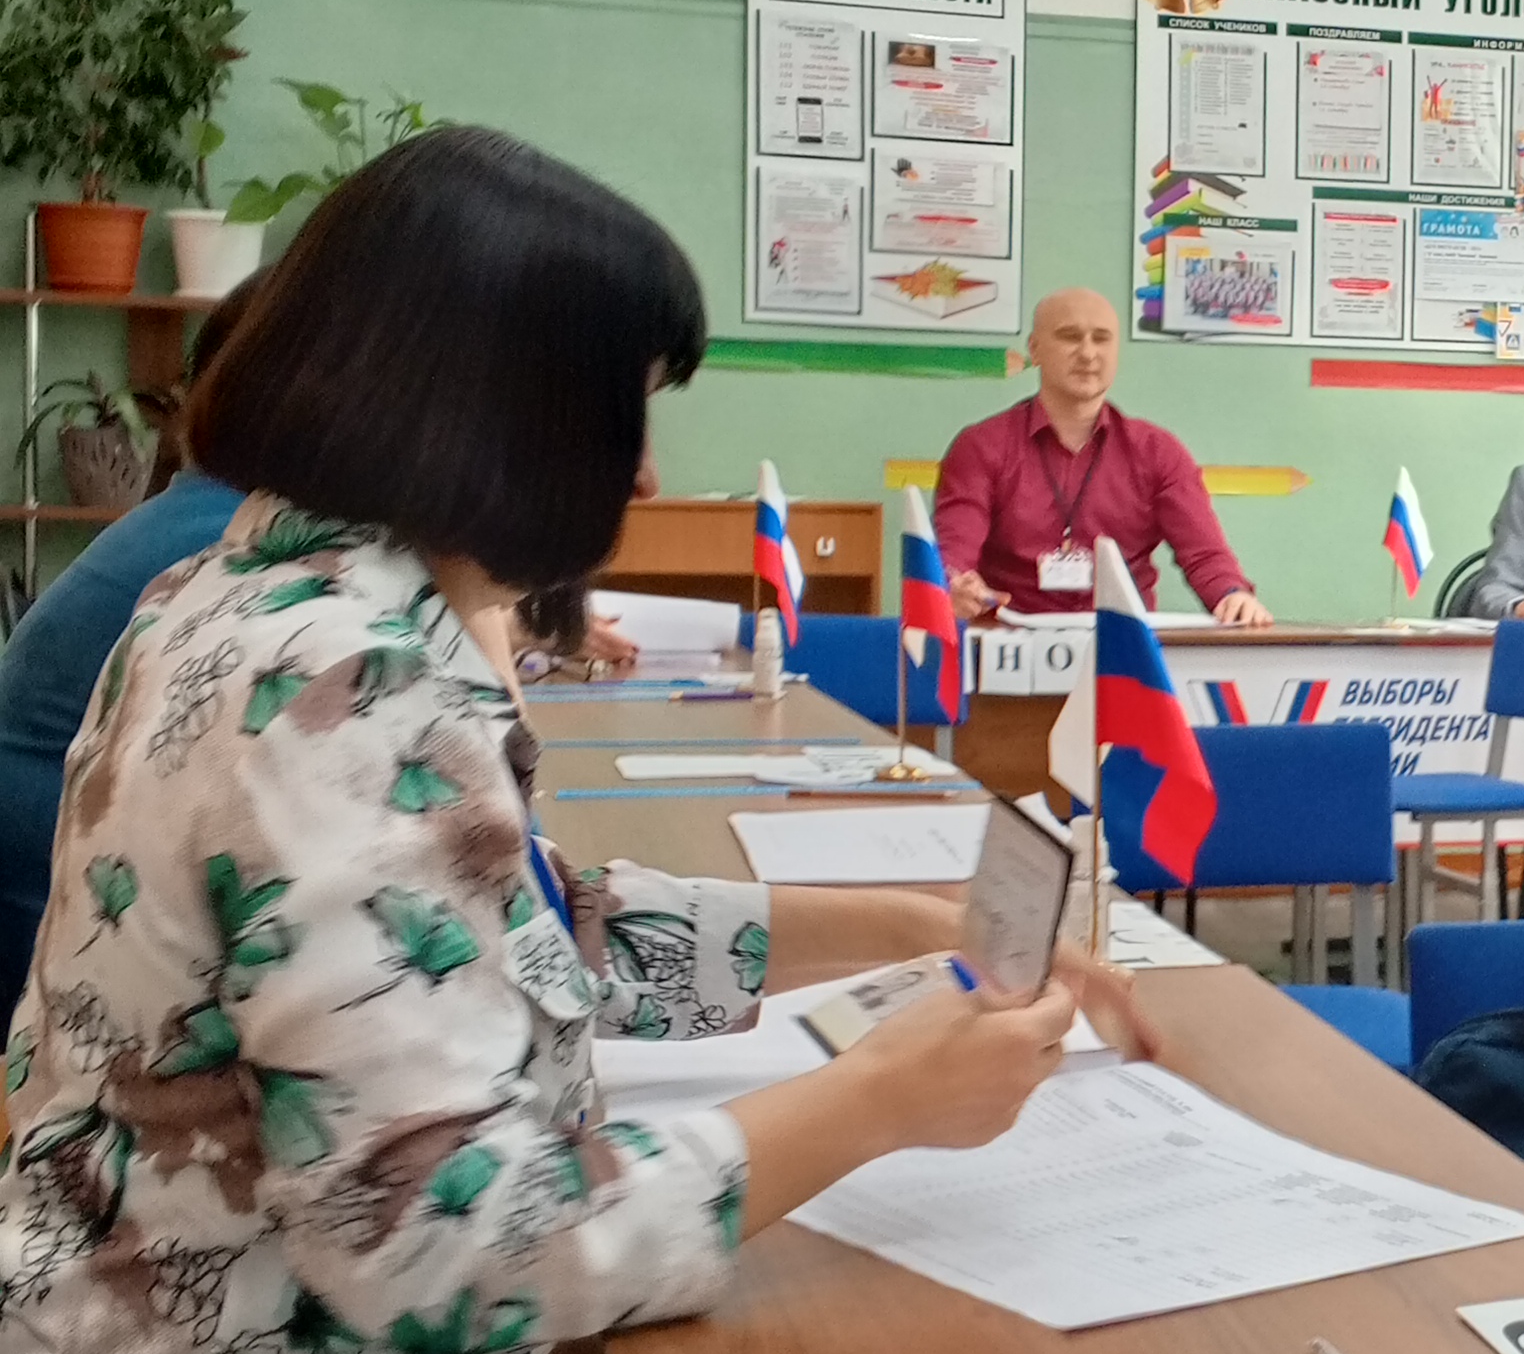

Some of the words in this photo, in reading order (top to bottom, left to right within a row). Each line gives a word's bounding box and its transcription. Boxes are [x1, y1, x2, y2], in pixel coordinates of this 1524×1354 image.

[1169, 18, 1210, 30] СПИСОК
[1213, 21, 1267, 33] УЧЕНИКОВ
[1308, 27, 1381, 40] ПОЗДРАВЛЯЕМ
[1408, 193, 1437, 203] НАШИ
[1440, 195, 1505, 206] ДОСТИЖЕНИЯ
[1198, 216, 1222, 226] НАШ
[1226, 218, 1260, 228] КЛАСС
[1422, 222, 1481, 236] ГРАМОТА
[1340, 678, 1460, 707] ВЫБОРЫ
[1333, 715, 1494, 747] ИДЕНТА
